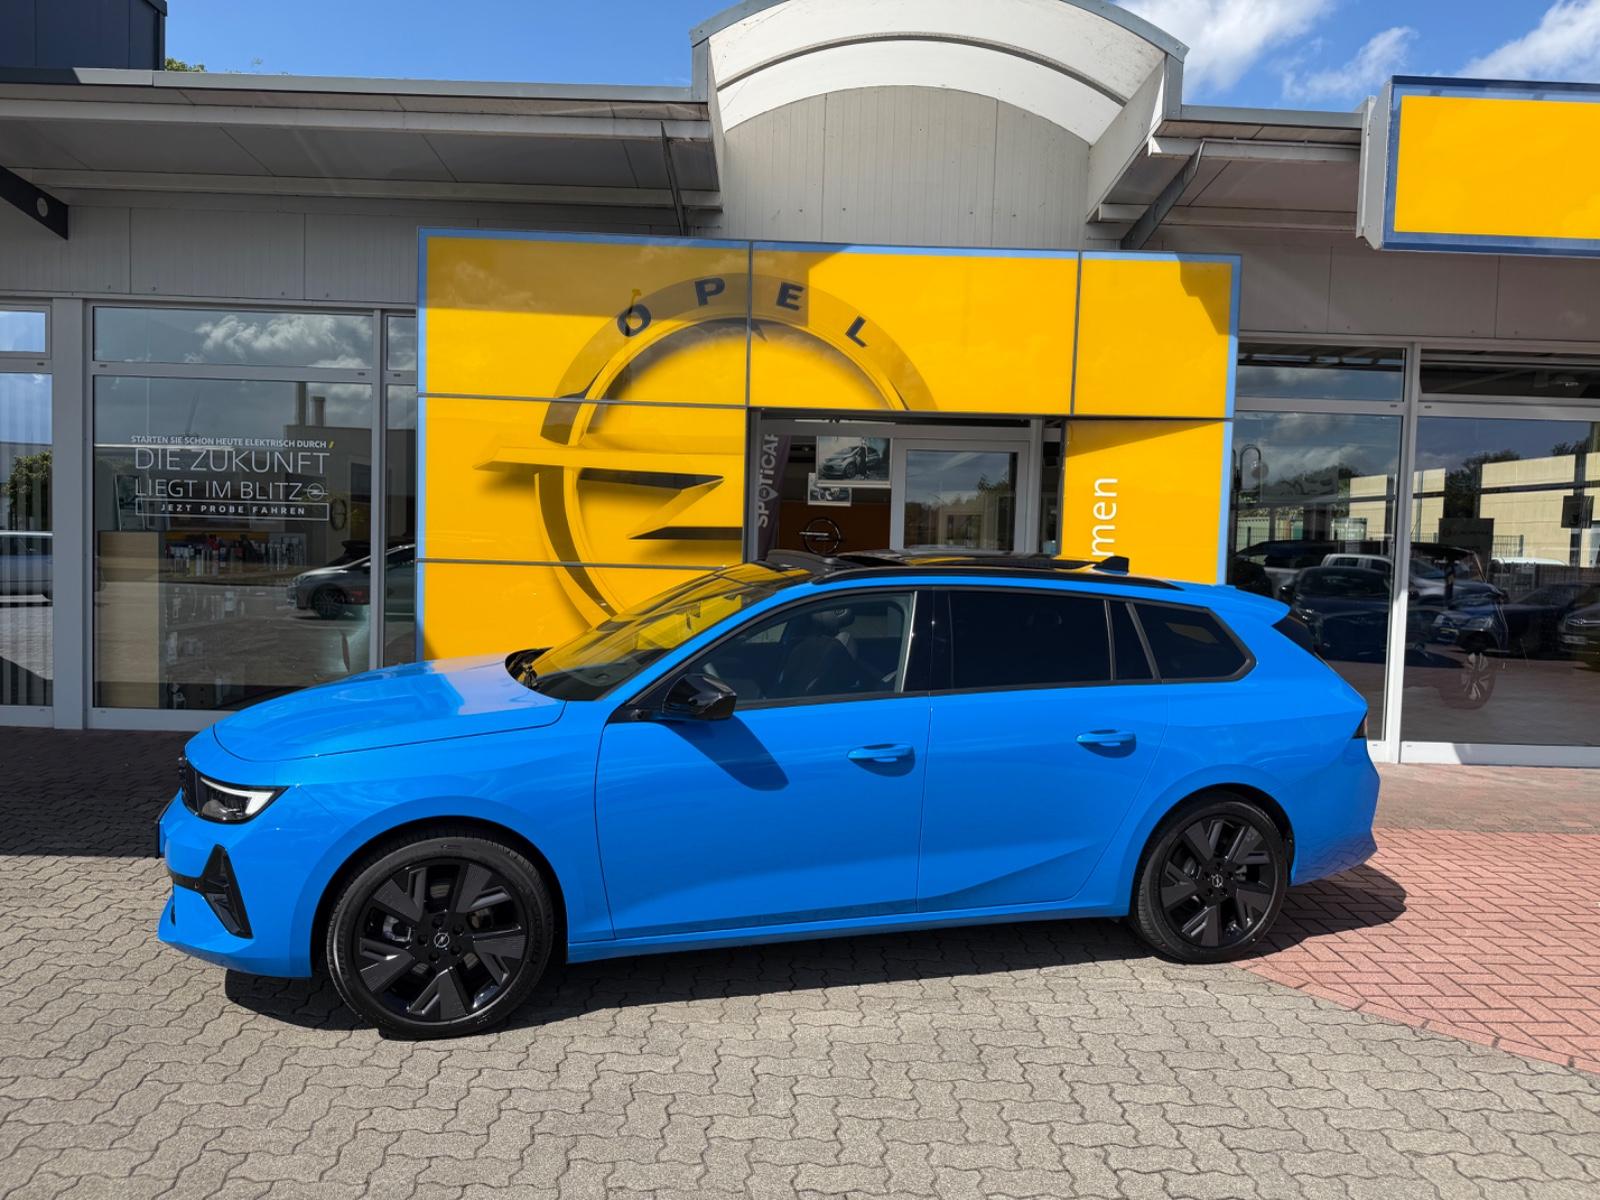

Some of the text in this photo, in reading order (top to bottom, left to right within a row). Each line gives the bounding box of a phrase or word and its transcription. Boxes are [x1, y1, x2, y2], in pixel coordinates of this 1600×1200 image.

[617, 277, 868, 348] OPEL
[131, 435, 168, 444] STARTEN
[170, 436, 183, 445] SIE
[216, 438, 243, 447] HEUTE
[245, 439, 295, 448] ELEKTRISCH
[297, 440, 326, 449] DURCH
[135, 447, 330, 475] DIE ZUKUNFT
[135, 479, 303, 500] LIEGT IM BLITZ
[160, 504, 305, 515] JEZT PROBE FAHREN
